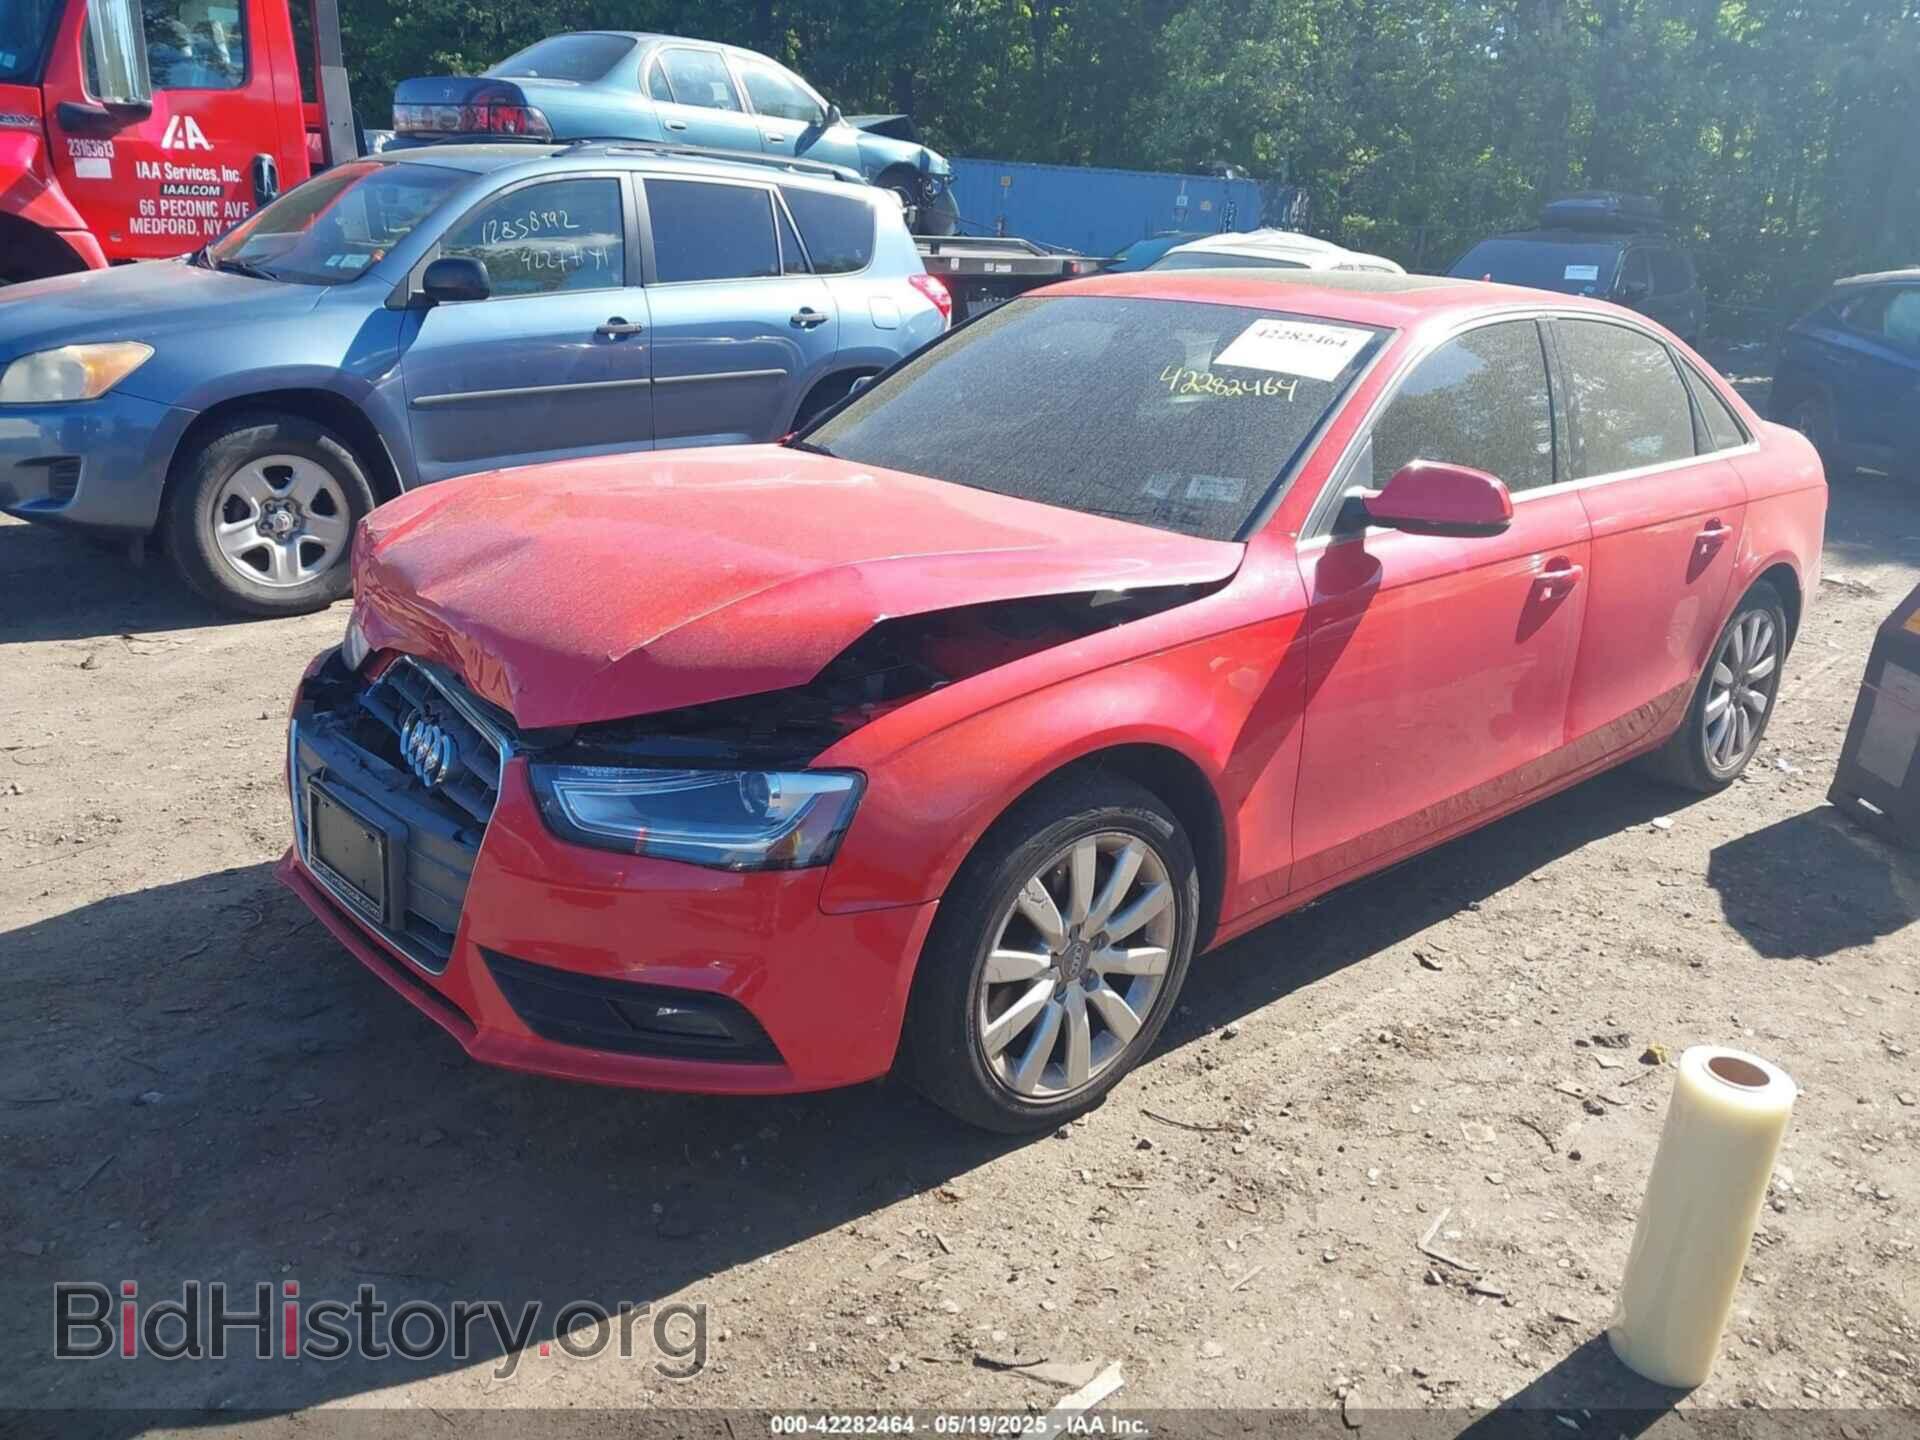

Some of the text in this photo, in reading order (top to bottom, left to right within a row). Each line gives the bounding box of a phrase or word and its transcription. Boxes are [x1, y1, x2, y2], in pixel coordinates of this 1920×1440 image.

[136, 161, 242, 183] IAA Services, Inc.
[163, 184, 220, 195] IAAI.COM
[140, 200, 249, 218] 66 PECONIC AVE
[129, 218, 200, 236] MEDFORD,
[203, 221, 222, 235] NY
[1256, 327, 1349, 349] 42282464
[1160, 365, 1299, 402] 42282464
